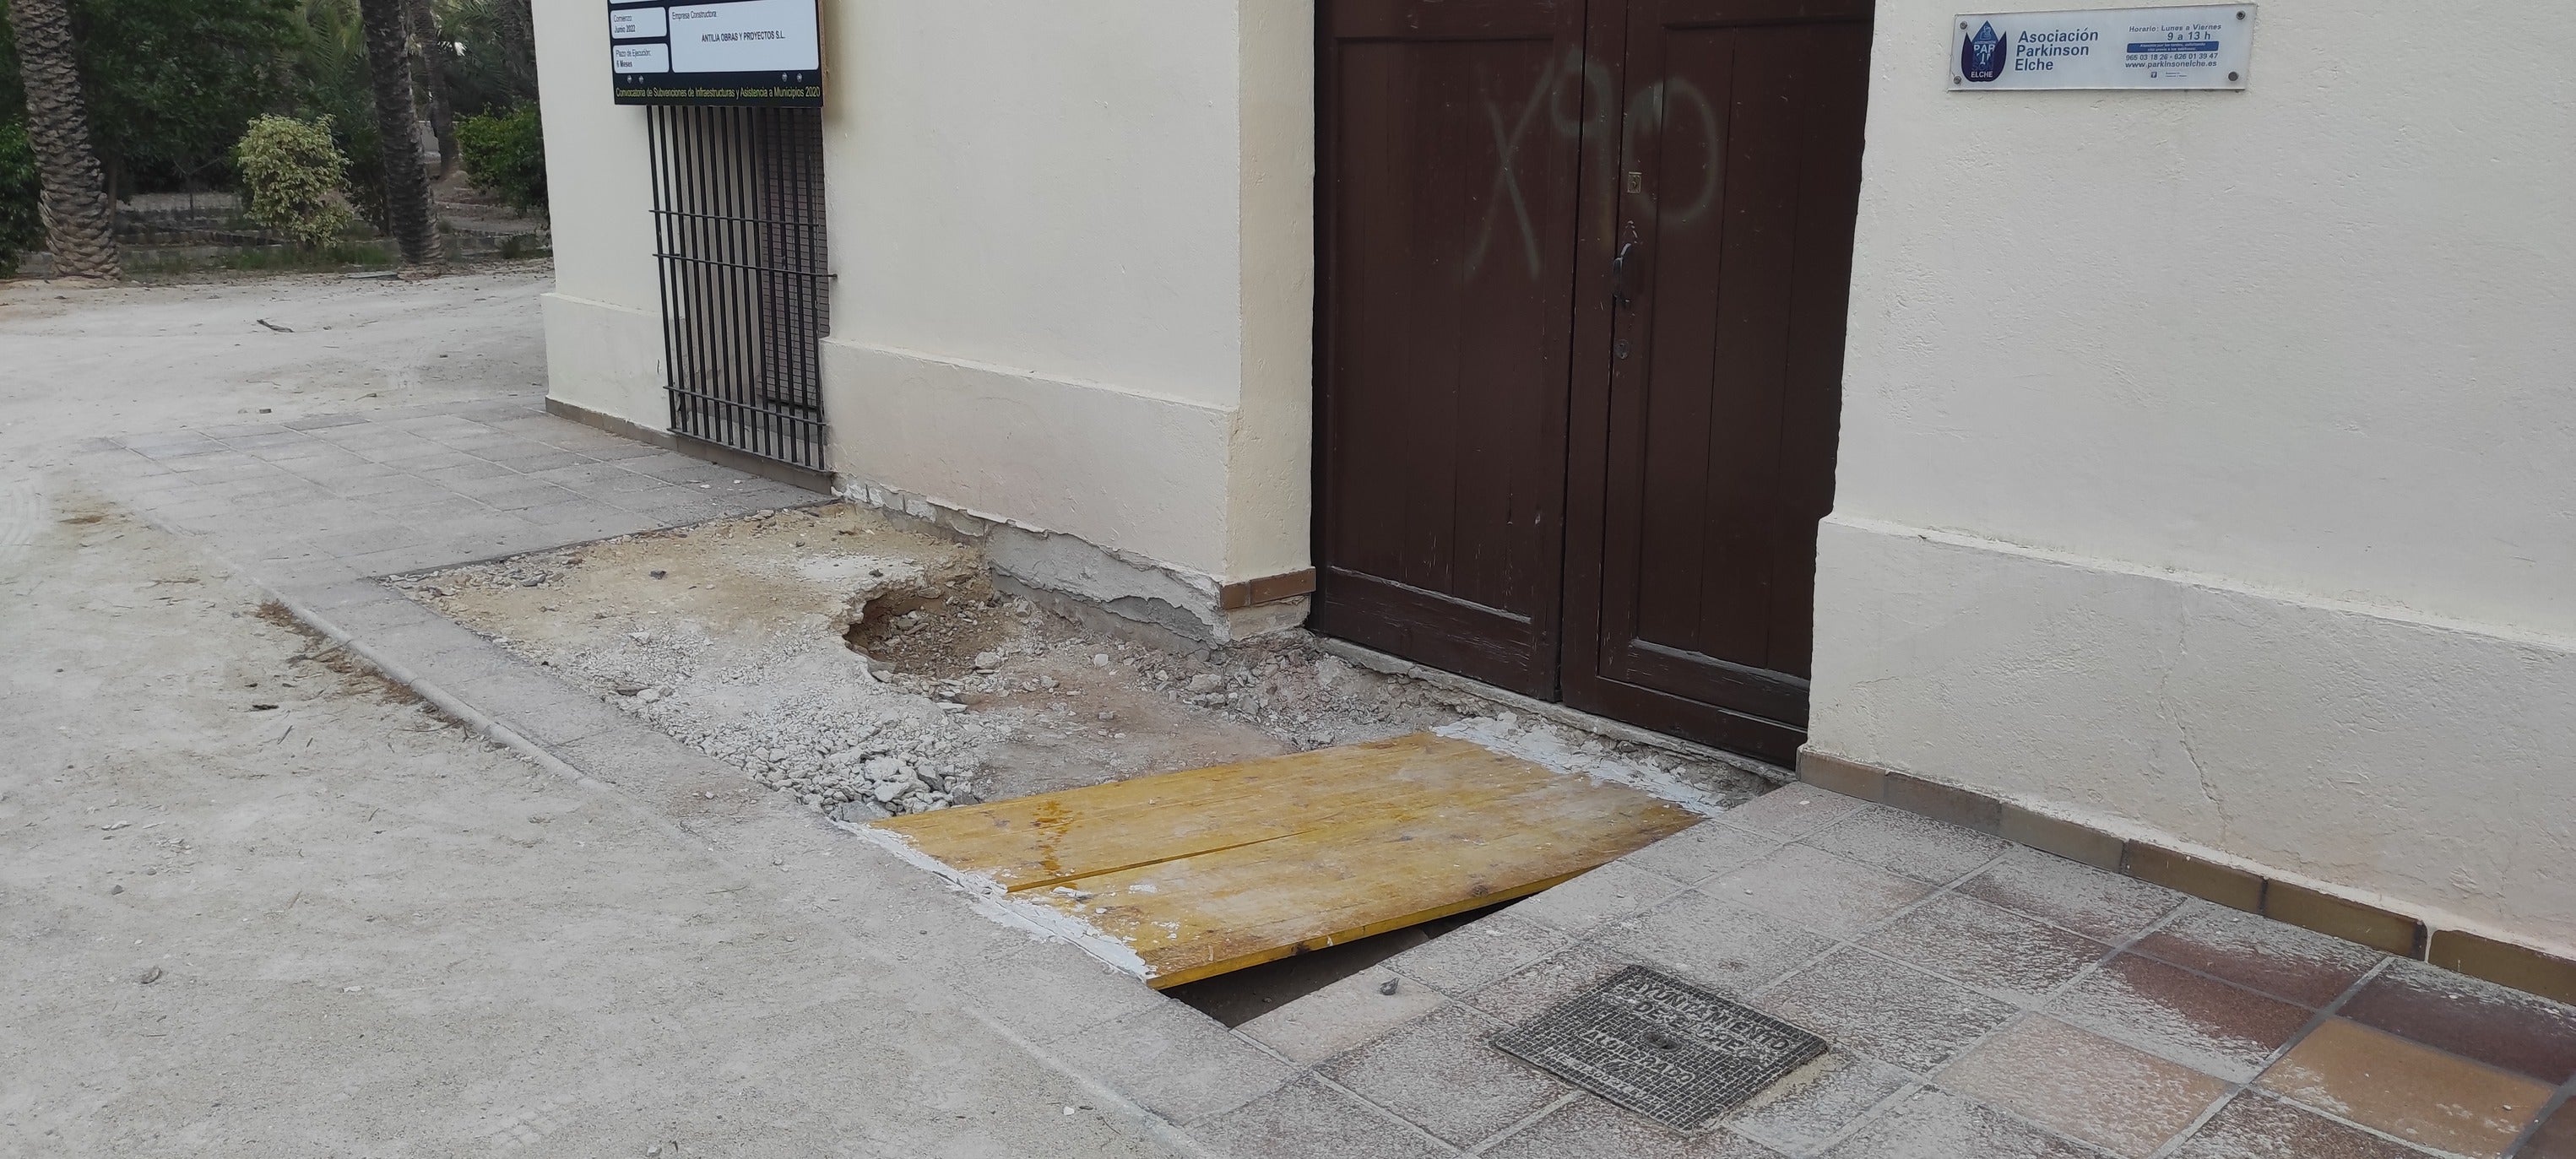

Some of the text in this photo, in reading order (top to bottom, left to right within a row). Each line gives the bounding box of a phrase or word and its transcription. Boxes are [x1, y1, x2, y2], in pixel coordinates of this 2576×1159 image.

[672, 10, 717, 20] Empresa Constructora
[702, 33, 720, 42] ANTILIA
[721, 32, 739, 41] OBRAS
[744, 31, 774, 41] PROYECTOS
[776, 30, 786, 39] S.L.
[2018, 27, 2098, 43] Asociación
[2167, 32, 2173, 41] 9
[2188, 31, 2200, 40] 13
[2205, 31, 2210, 40] h
[2016, 43, 2089, 57] Parkinson
[2015, 58, 2053, 71] Elche
[2125, 60, 2217, 68] www.parkinsonelche.es
[616, 87, 646, 97] Convocatoria
[647, 87, 653, 97] de
[653, 87, 686, 97] Subvenciones
[688, 87, 695, 97] de
[695, 87, 735, 97] Infraestructuras
[736, 89, 740, 100] y
[740, 87, 768, 97] Asistencia
[773, 86, 804, 99] Municipios
[805, 86, 820, 97] 2020
[1623, 978, 1795, 1052] AYUNTAMIENTO
[1629, 999, 1672, 1021] DE
